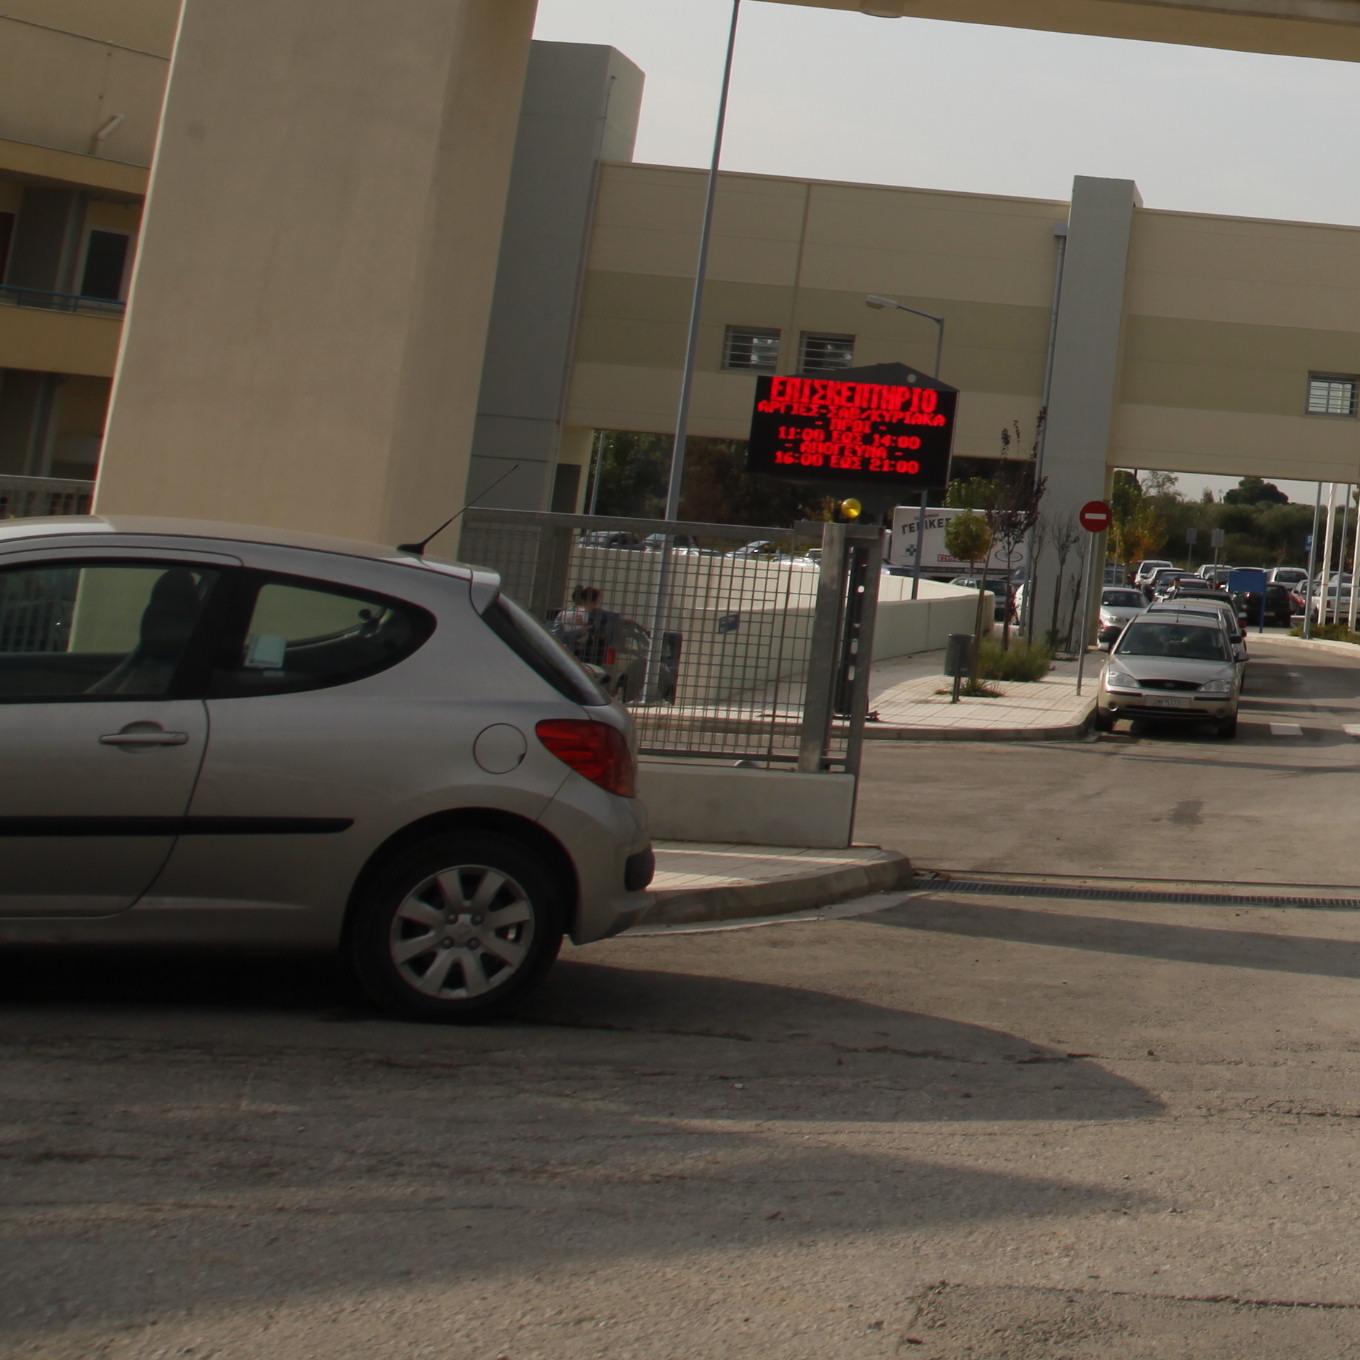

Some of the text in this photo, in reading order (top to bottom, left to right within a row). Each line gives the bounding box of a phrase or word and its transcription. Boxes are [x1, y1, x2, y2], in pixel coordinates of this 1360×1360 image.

[770, 376, 938, 413] ΕΠΙΣΚΕΠΤΗΡΙΟ
[829, 418, 872, 433] ΠΡΩΙ
[778, 426, 922, 449] 11:00 ΕΩΣ 14:00
[774, 451, 920, 474] 16:00 ΕΩΣ 21:00
